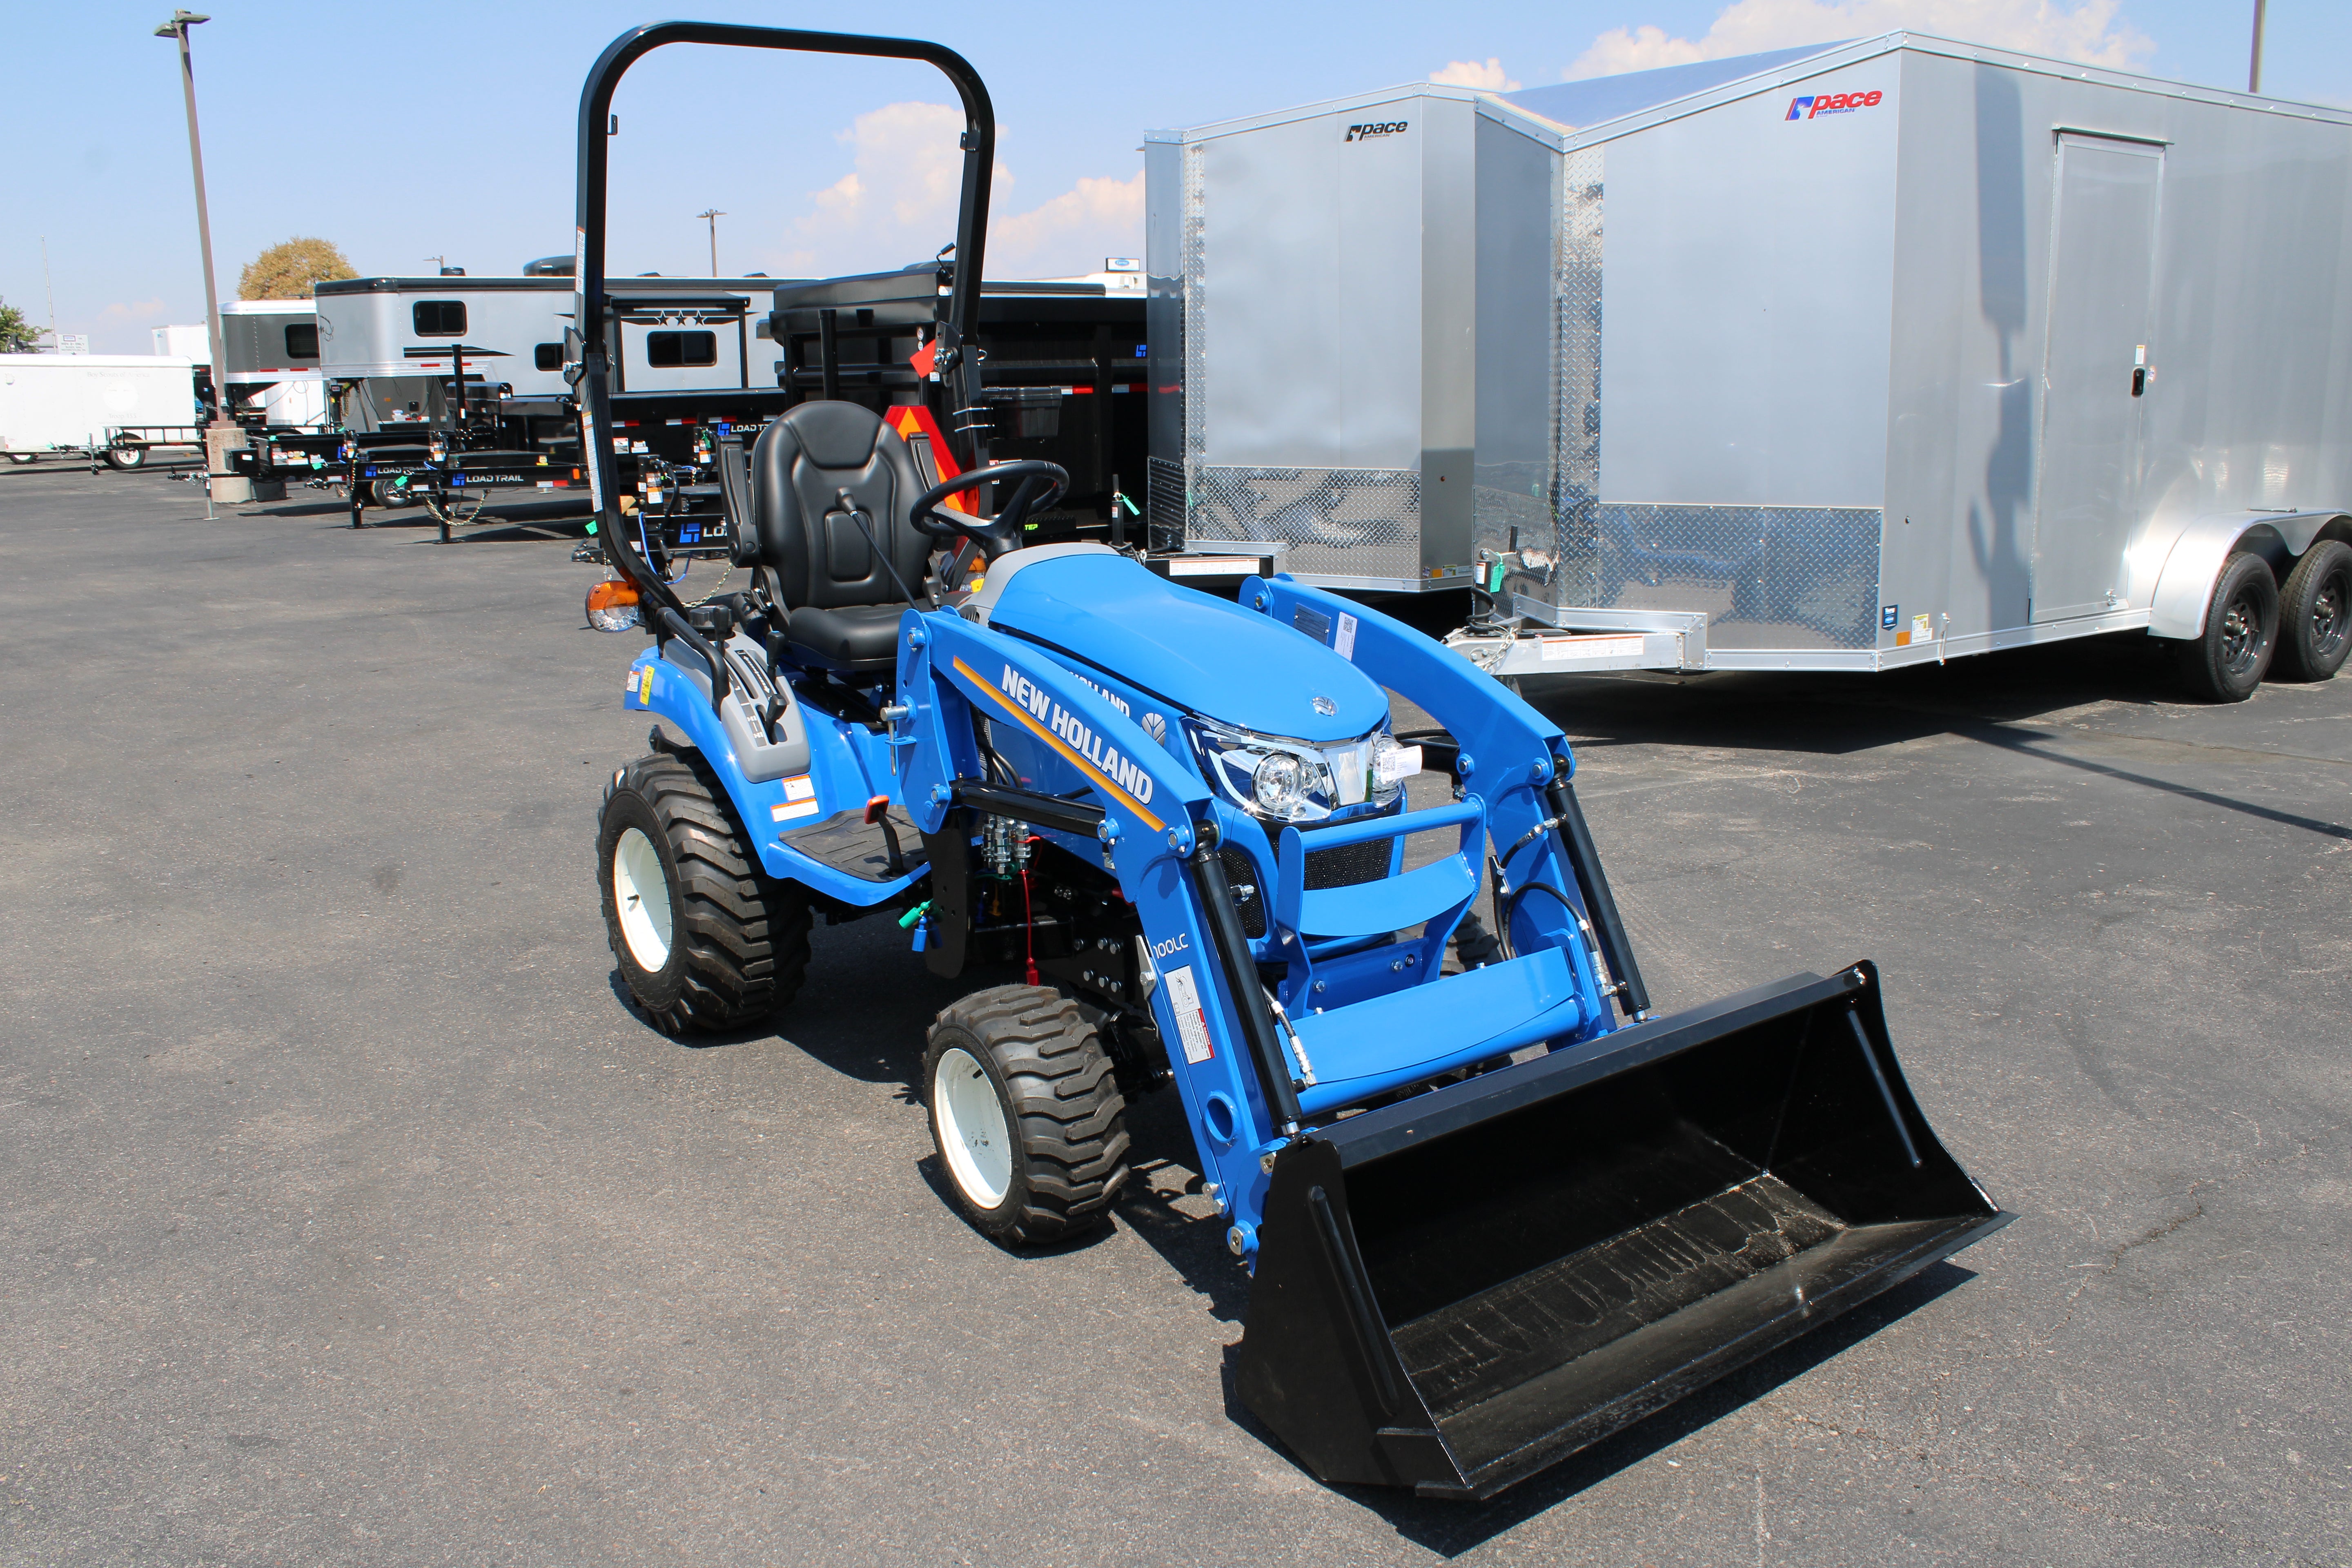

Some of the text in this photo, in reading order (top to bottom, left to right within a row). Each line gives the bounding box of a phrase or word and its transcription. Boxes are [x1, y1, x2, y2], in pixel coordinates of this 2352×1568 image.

[1807, 90, 1883, 119] pace
[1359, 121, 1408, 141] pace
[1002, 664, 1153, 805] NEW HOLLAND
[1153, 933, 1189, 959] 100LC
